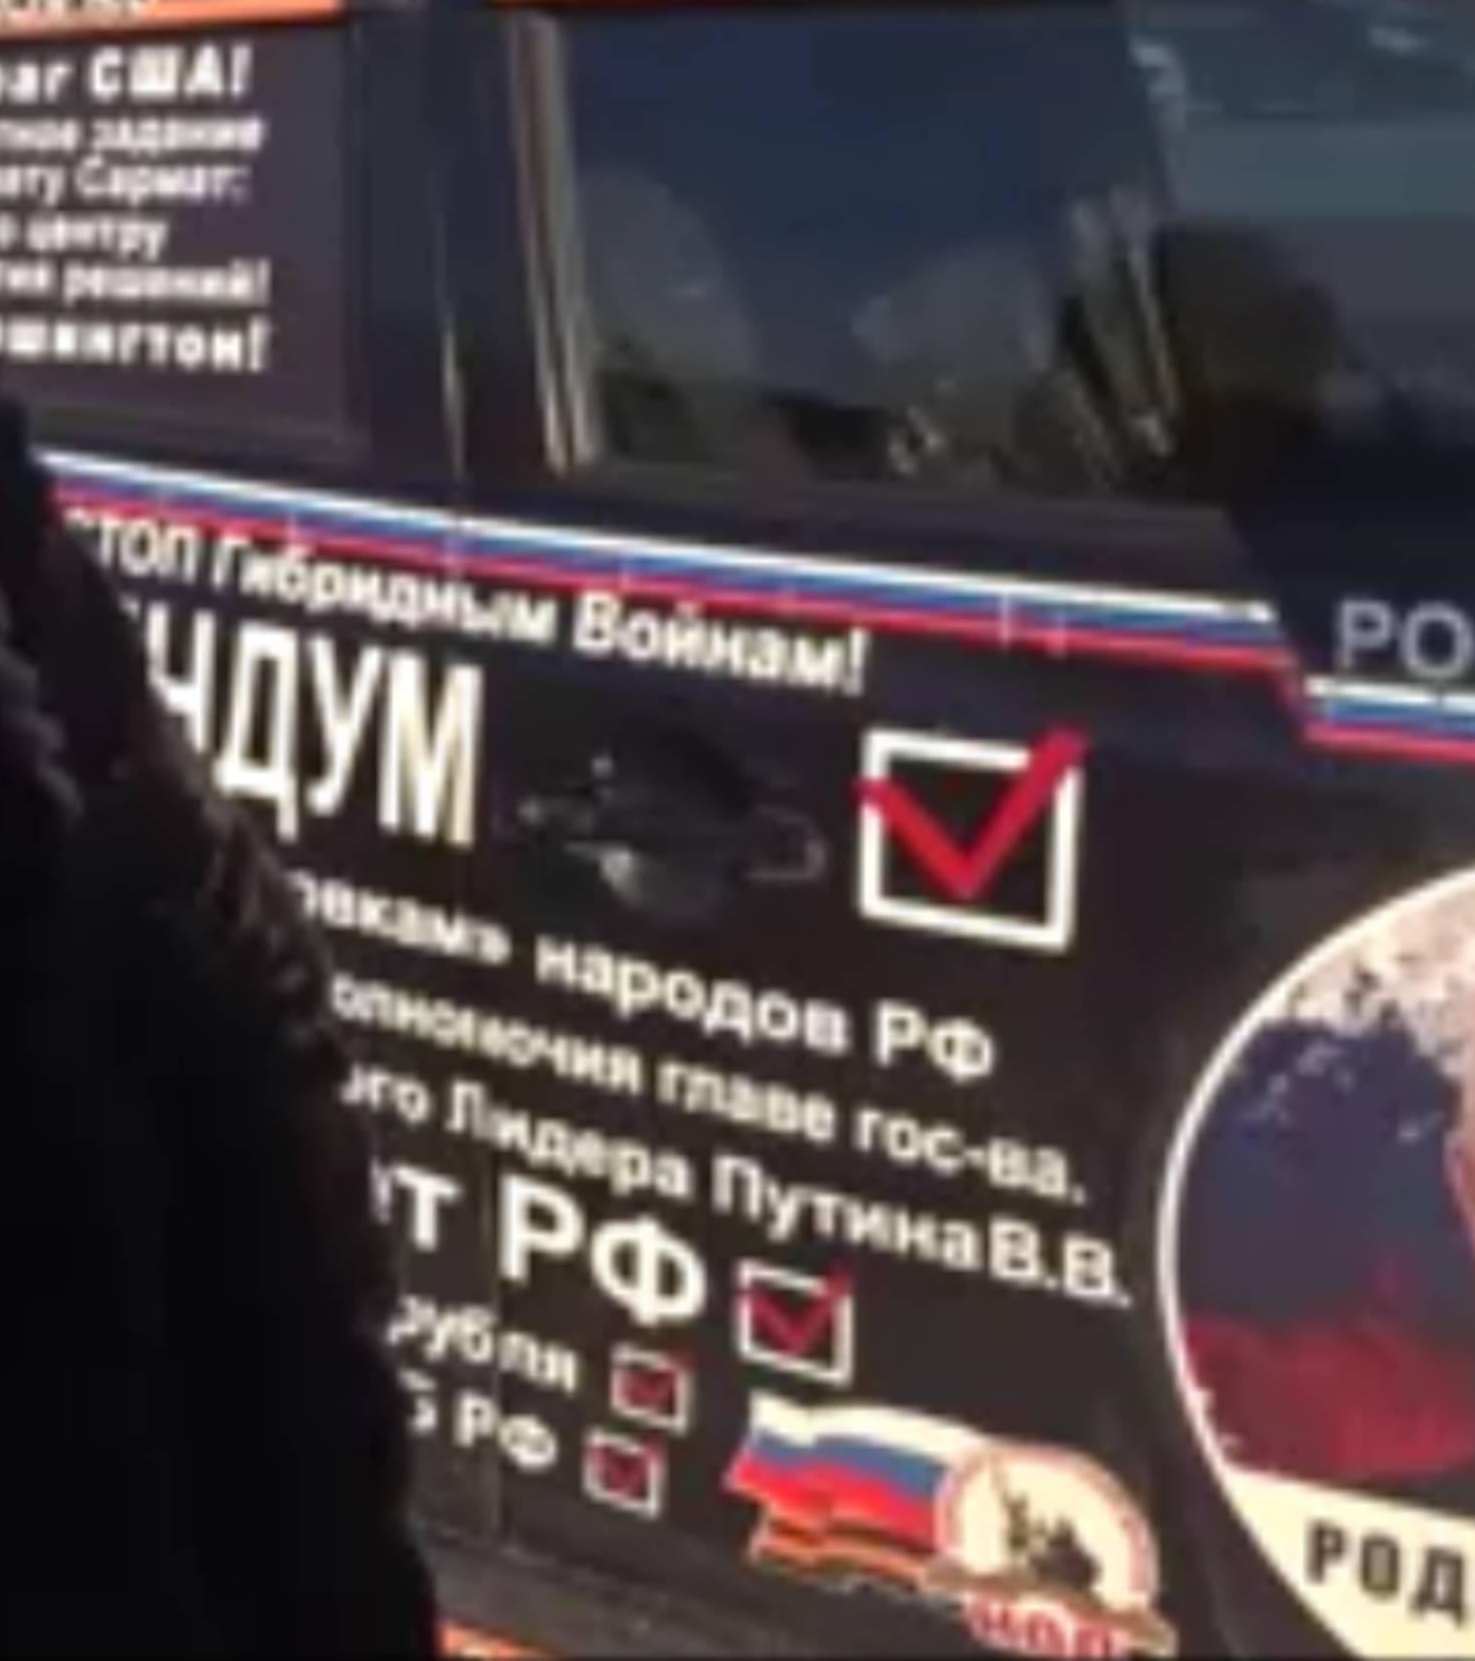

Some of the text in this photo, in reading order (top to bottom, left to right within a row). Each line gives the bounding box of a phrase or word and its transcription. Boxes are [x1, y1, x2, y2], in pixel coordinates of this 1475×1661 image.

[88, 44, 254, 102] США!
[213, 534, 557, 645] Гибридным
[573, 587, 871, 697] Войнам!
[535, 933, 850, 1056] народов
[875, 998, 996, 1084] РФ
[445, 1079, 694, 1199] Лидера
[500, 1172, 707, 1327] РФ
[456, 1391, 559, 1472] РФ
